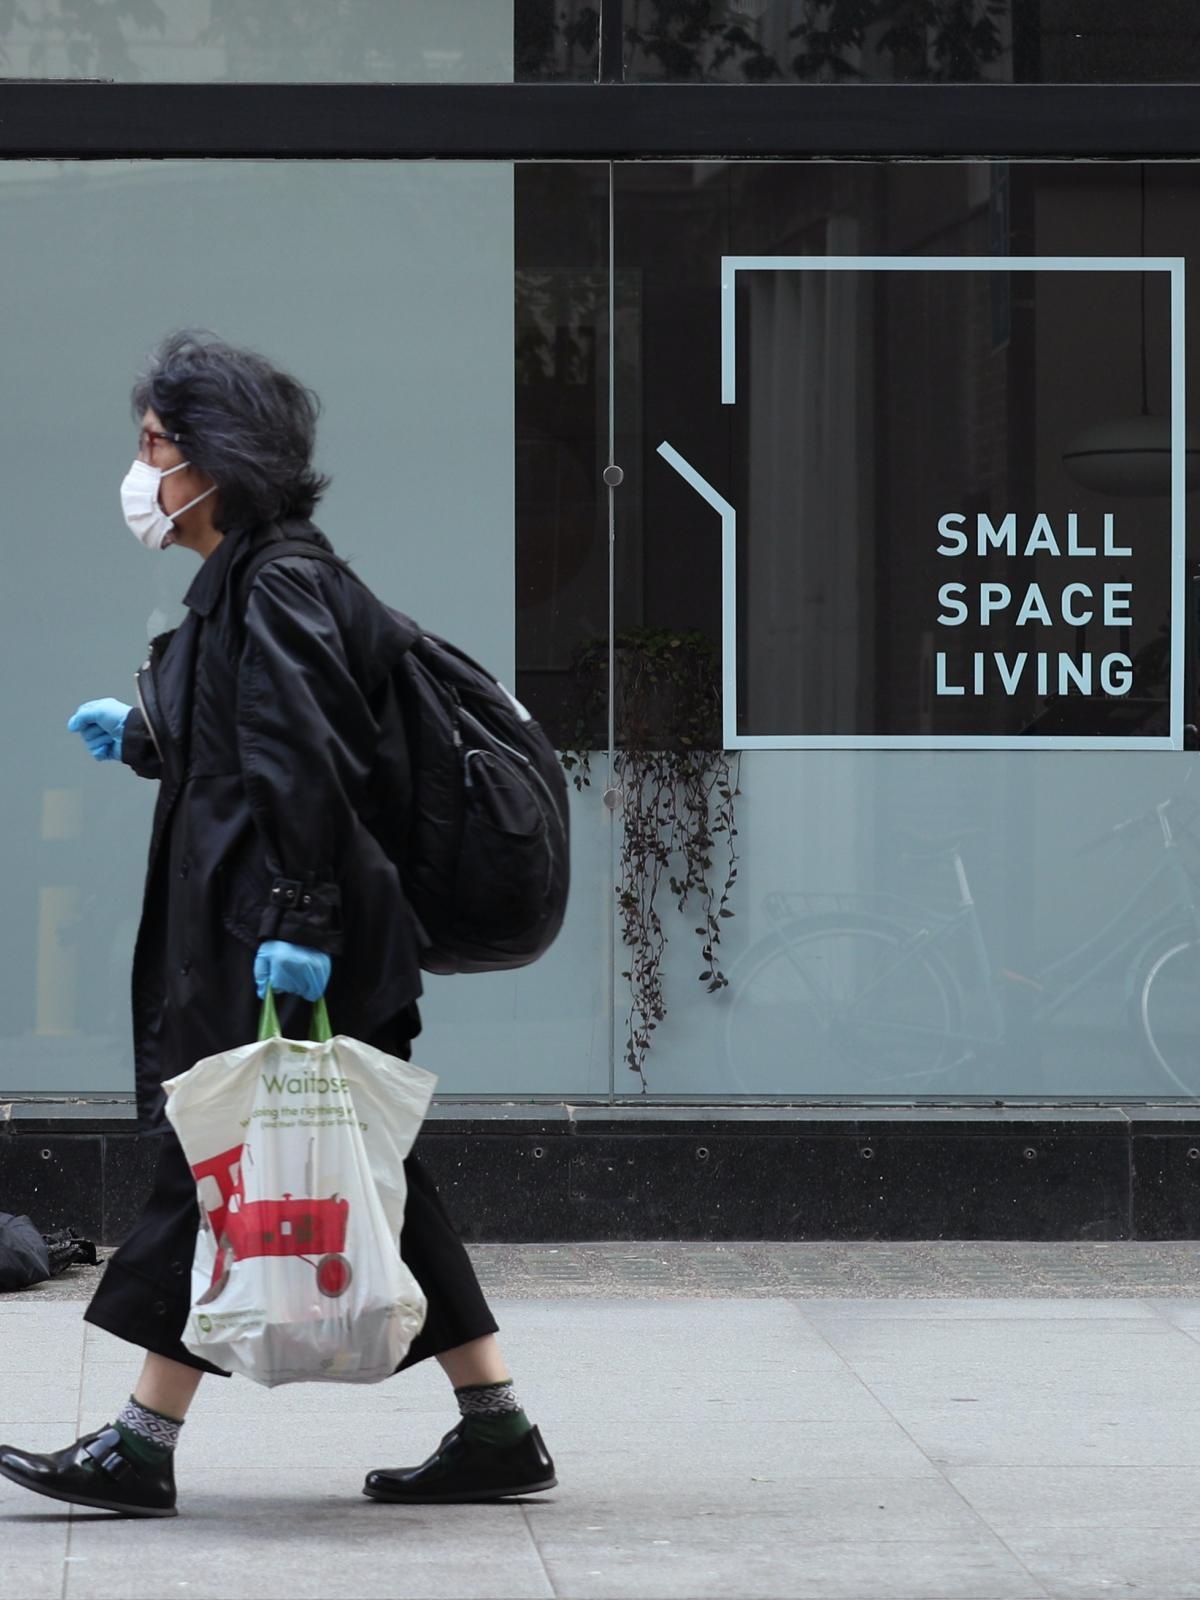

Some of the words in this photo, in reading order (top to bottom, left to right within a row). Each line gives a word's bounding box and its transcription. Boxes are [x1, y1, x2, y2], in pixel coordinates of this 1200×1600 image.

[936, 513, 1132, 556] SMALL
[936, 582, 1132, 626] SPACE
[936, 652, 1133, 696] LIVING
